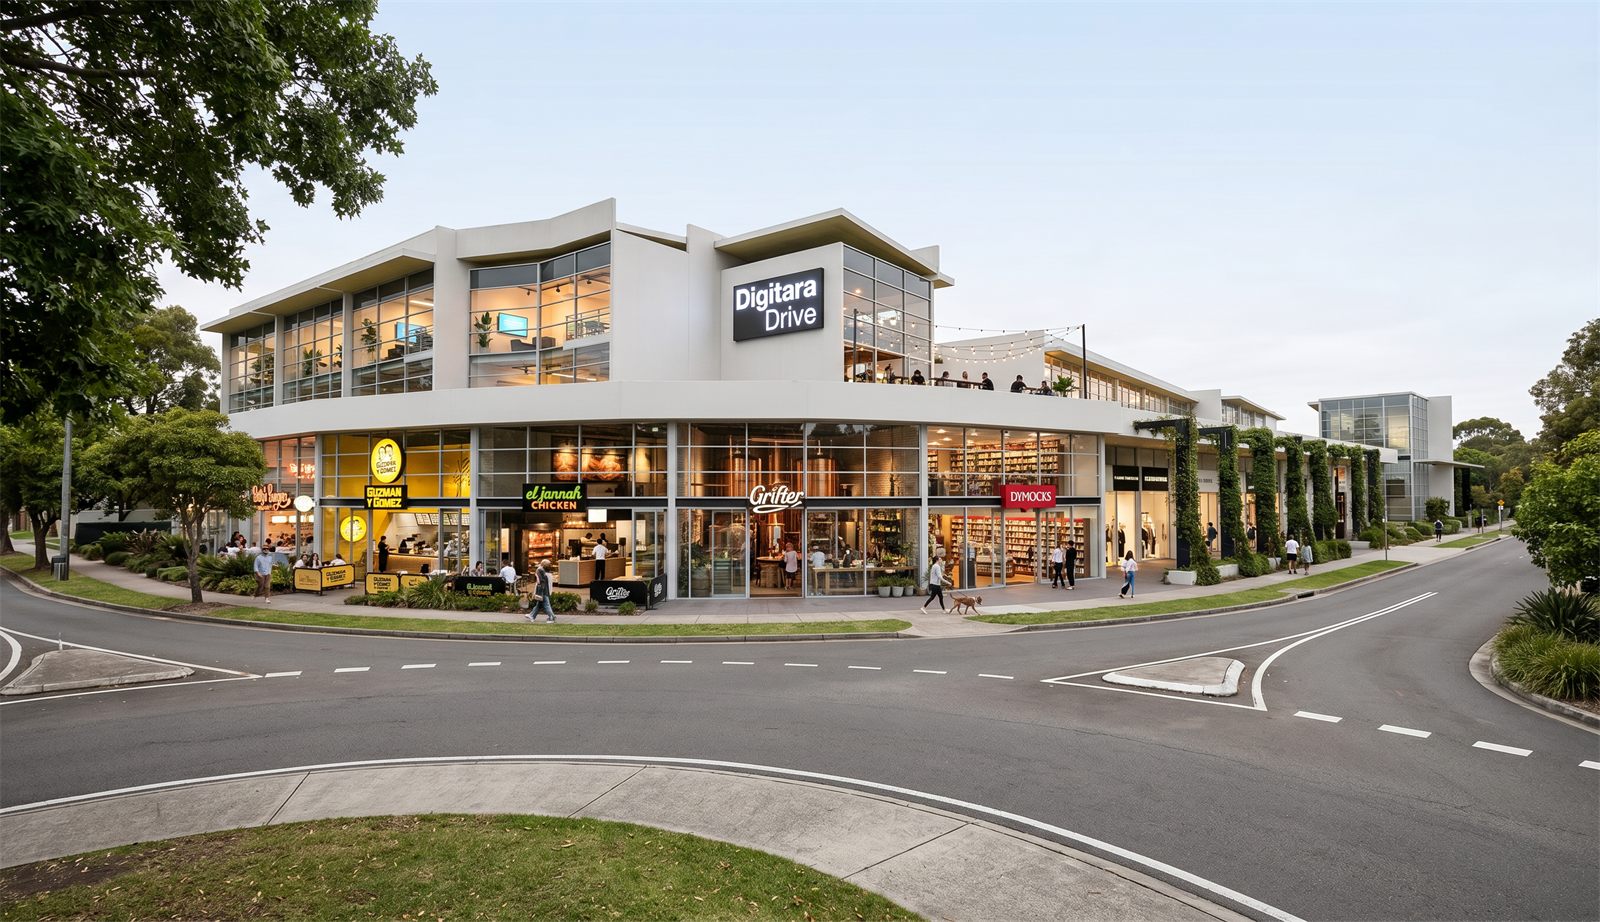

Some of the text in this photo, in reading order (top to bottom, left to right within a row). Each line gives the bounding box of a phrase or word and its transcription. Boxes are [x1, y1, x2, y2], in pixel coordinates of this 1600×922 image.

[735, 279, 817, 312] Digitara
[765, 306, 817, 332] Drive
[367, 487, 402, 498] GUZMAN
[526, 485, 583, 504] el jannah
[749, 485, 805, 510] Grifter
[1010, 491, 1052, 502] DYMOCKS
[367, 497, 402, 508] Y GOMEZ
[531, 500, 577, 510] CHICKEN
